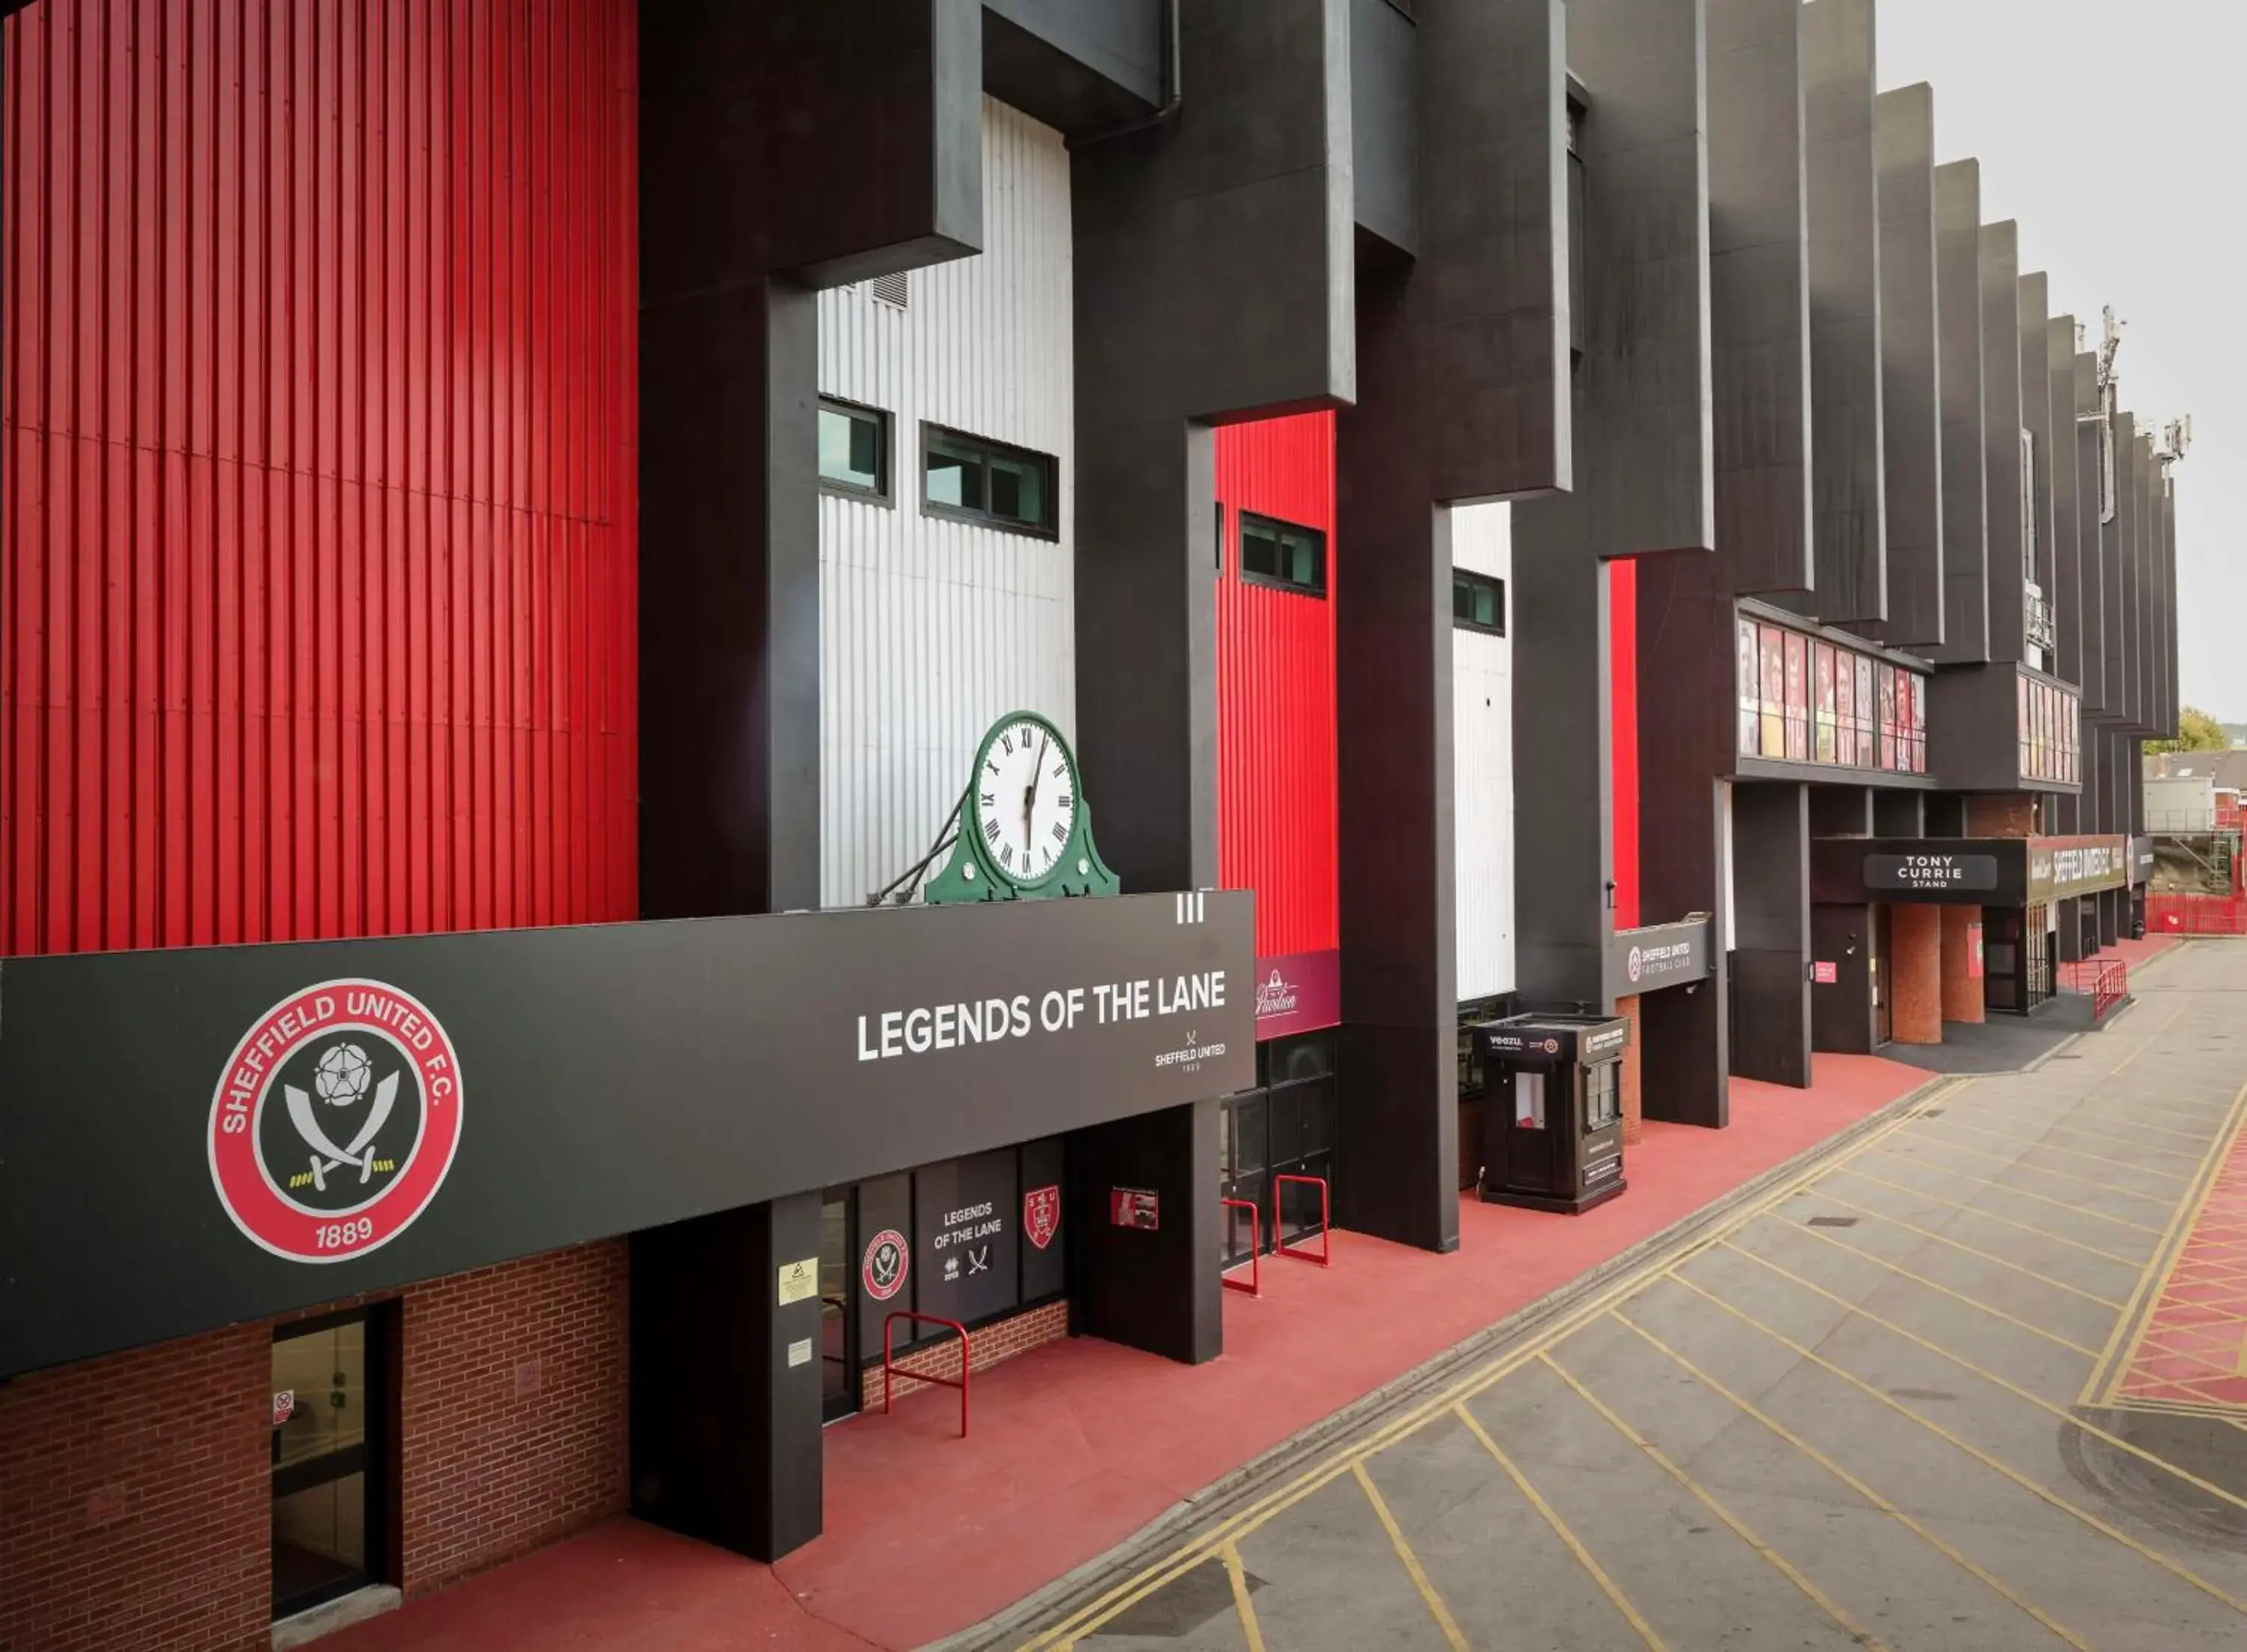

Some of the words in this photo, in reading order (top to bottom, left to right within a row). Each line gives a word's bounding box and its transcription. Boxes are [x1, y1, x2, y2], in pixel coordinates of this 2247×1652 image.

[1021, 728, 1032, 748] XII
[1053, 764, 1065, 778] II
[1058, 795, 1070, 807] III
[1897, 868, 1962, 878] CURRIE
[1906, 856, 1953, 866] TONY
[856, 994, 1031, 1061] LEGENDS
[1040, 990, 1085, 1032] OF
[1092, 980, 1150, 1024] THE
[1156, 971, 1225, 1015] LANE
[222, 995, 335, 1134] SHEFFIELD
[346, 991, 432, 1051] UNITED
[426, 1054, 452, 1106] F.C.
[1155, 1048, 1197, 1067] SHEFFIELD
[1198, 1043, 1226, 1059] UNITED
[944, 1202, 992, 1227] LEGENDS
[315, 1216, 373, 1248] 1889
[934, 1233, 950, 1250] OF
[952, 1227, 973, 1245] THE
[974, 1218, 1001, 1238] LANE
